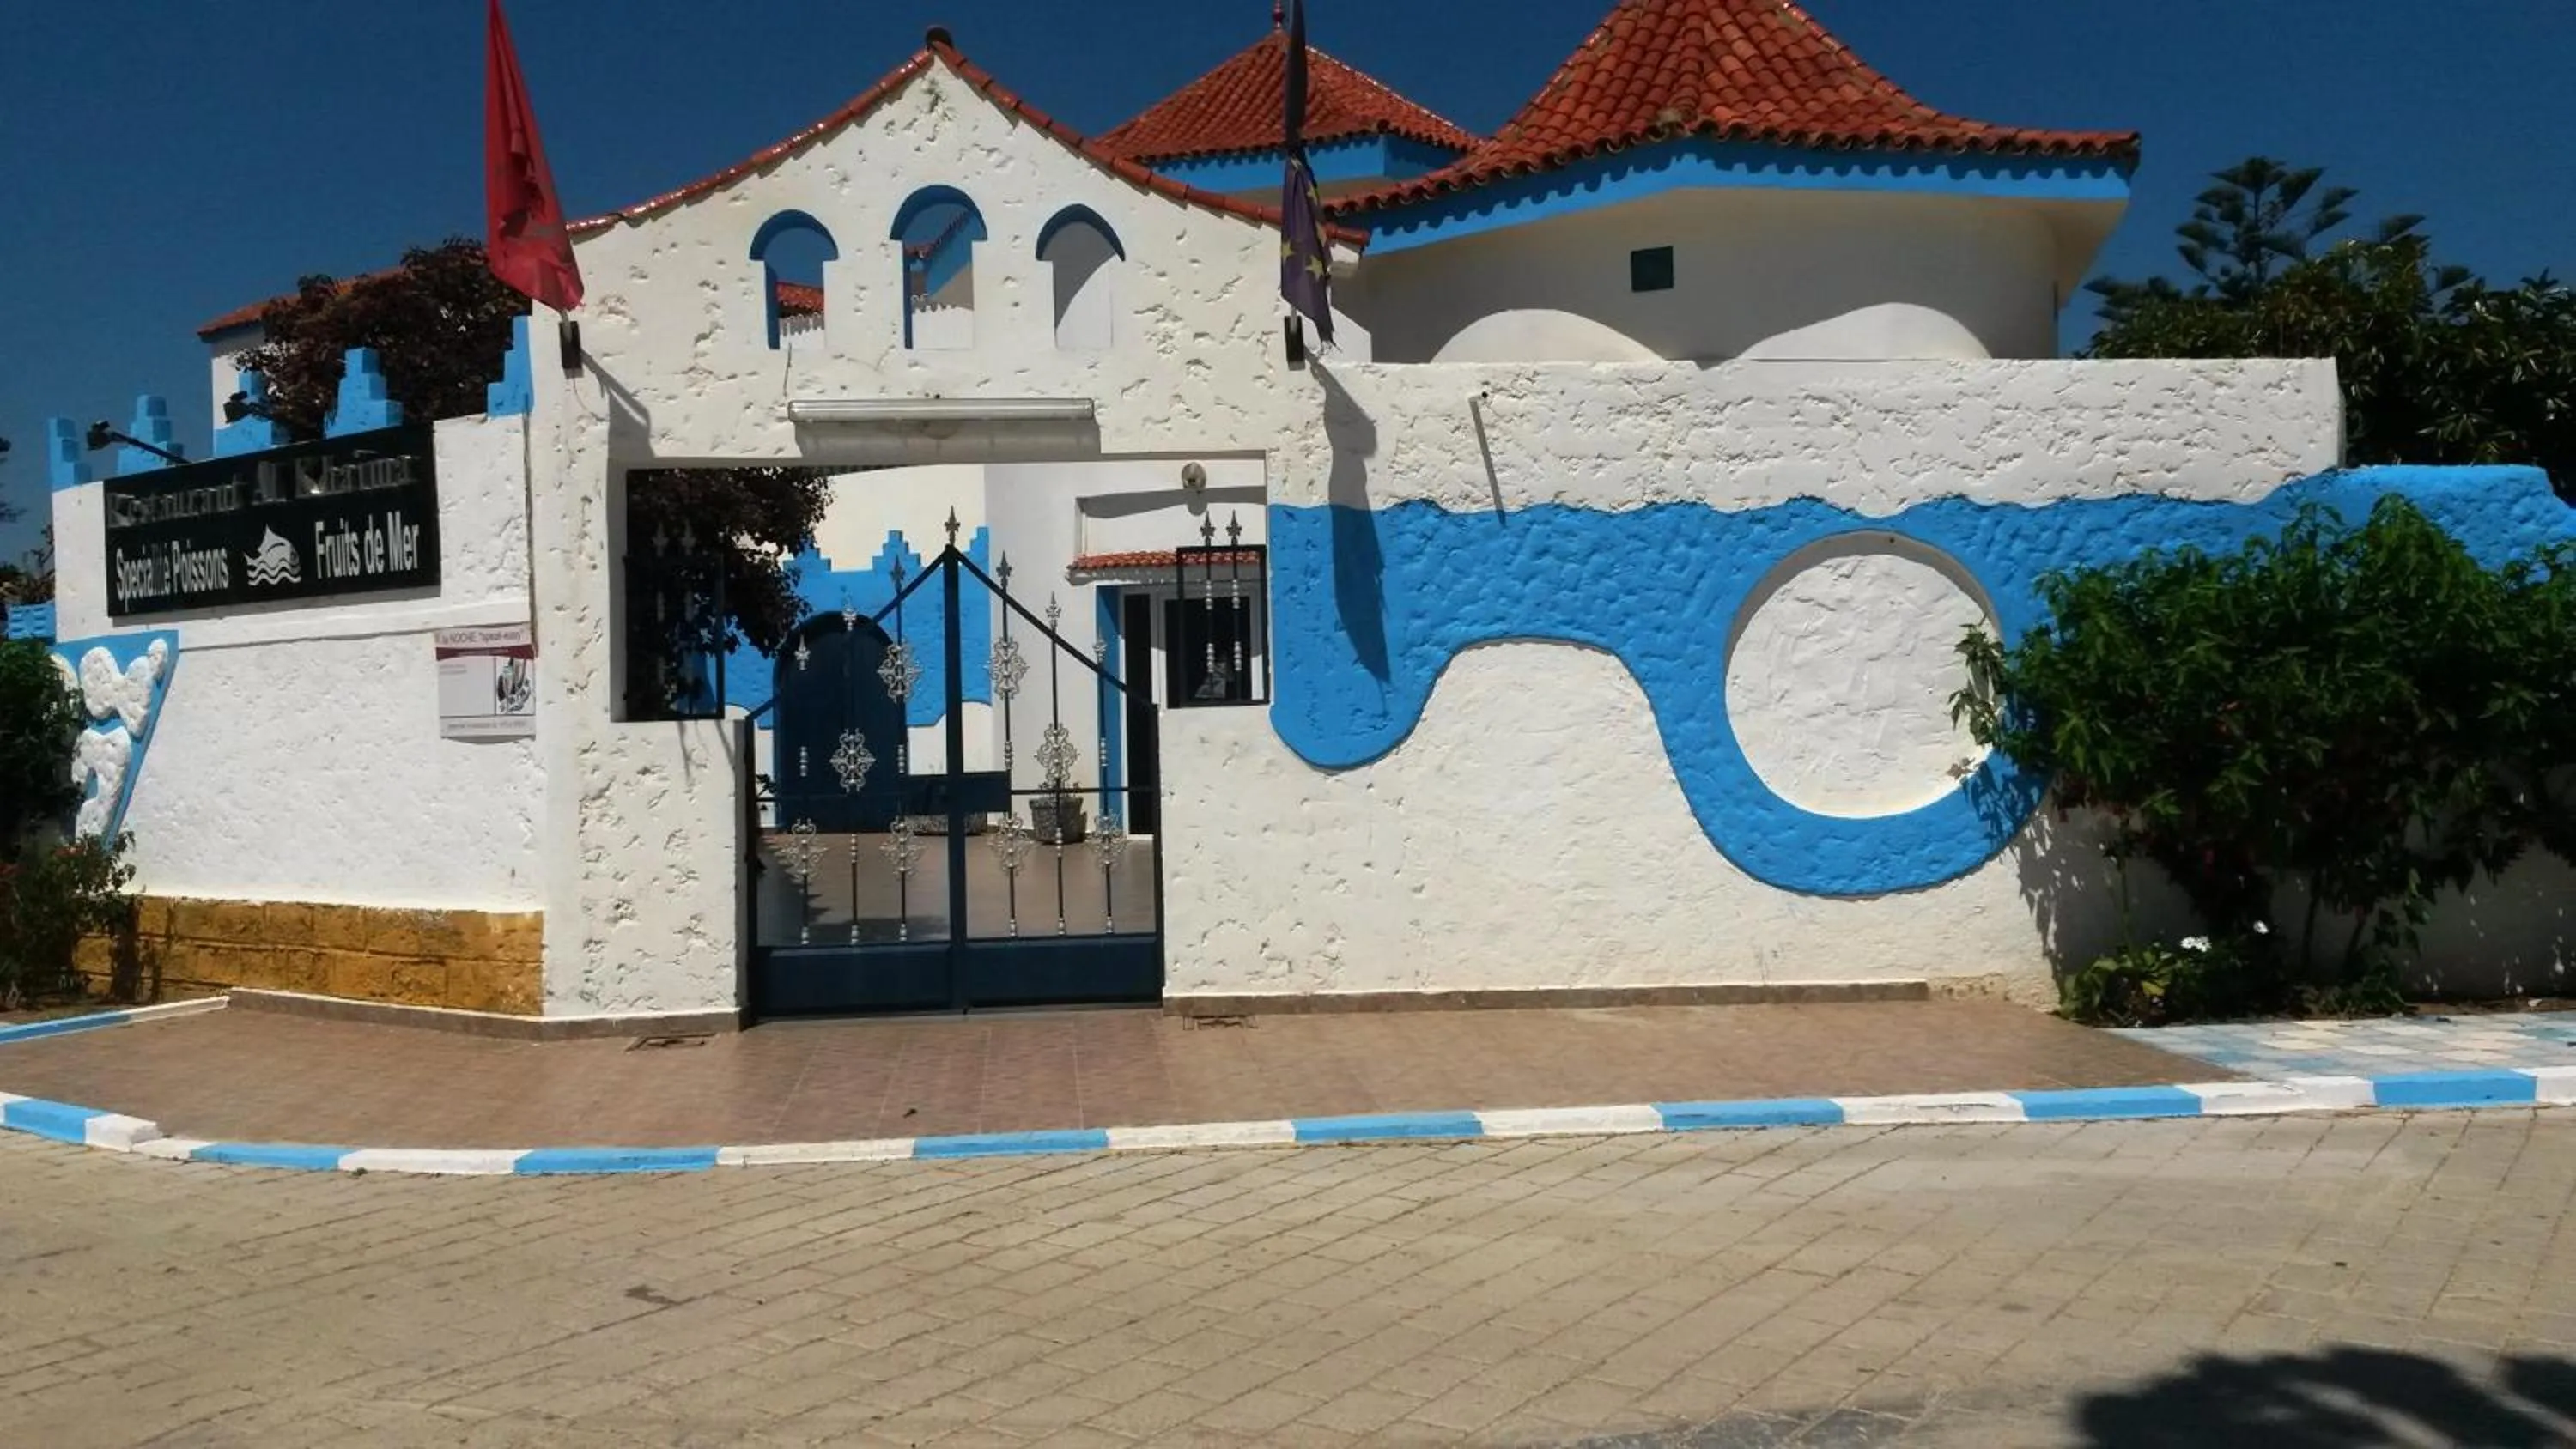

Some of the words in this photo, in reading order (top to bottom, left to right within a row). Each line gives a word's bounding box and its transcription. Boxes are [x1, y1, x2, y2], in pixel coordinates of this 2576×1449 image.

[172, 538, 229, 594] Poissons
[315, 517, 361, 579] Fruits
[363, 513, 385, 574] de
[386, 509, 420, 573] Mer
